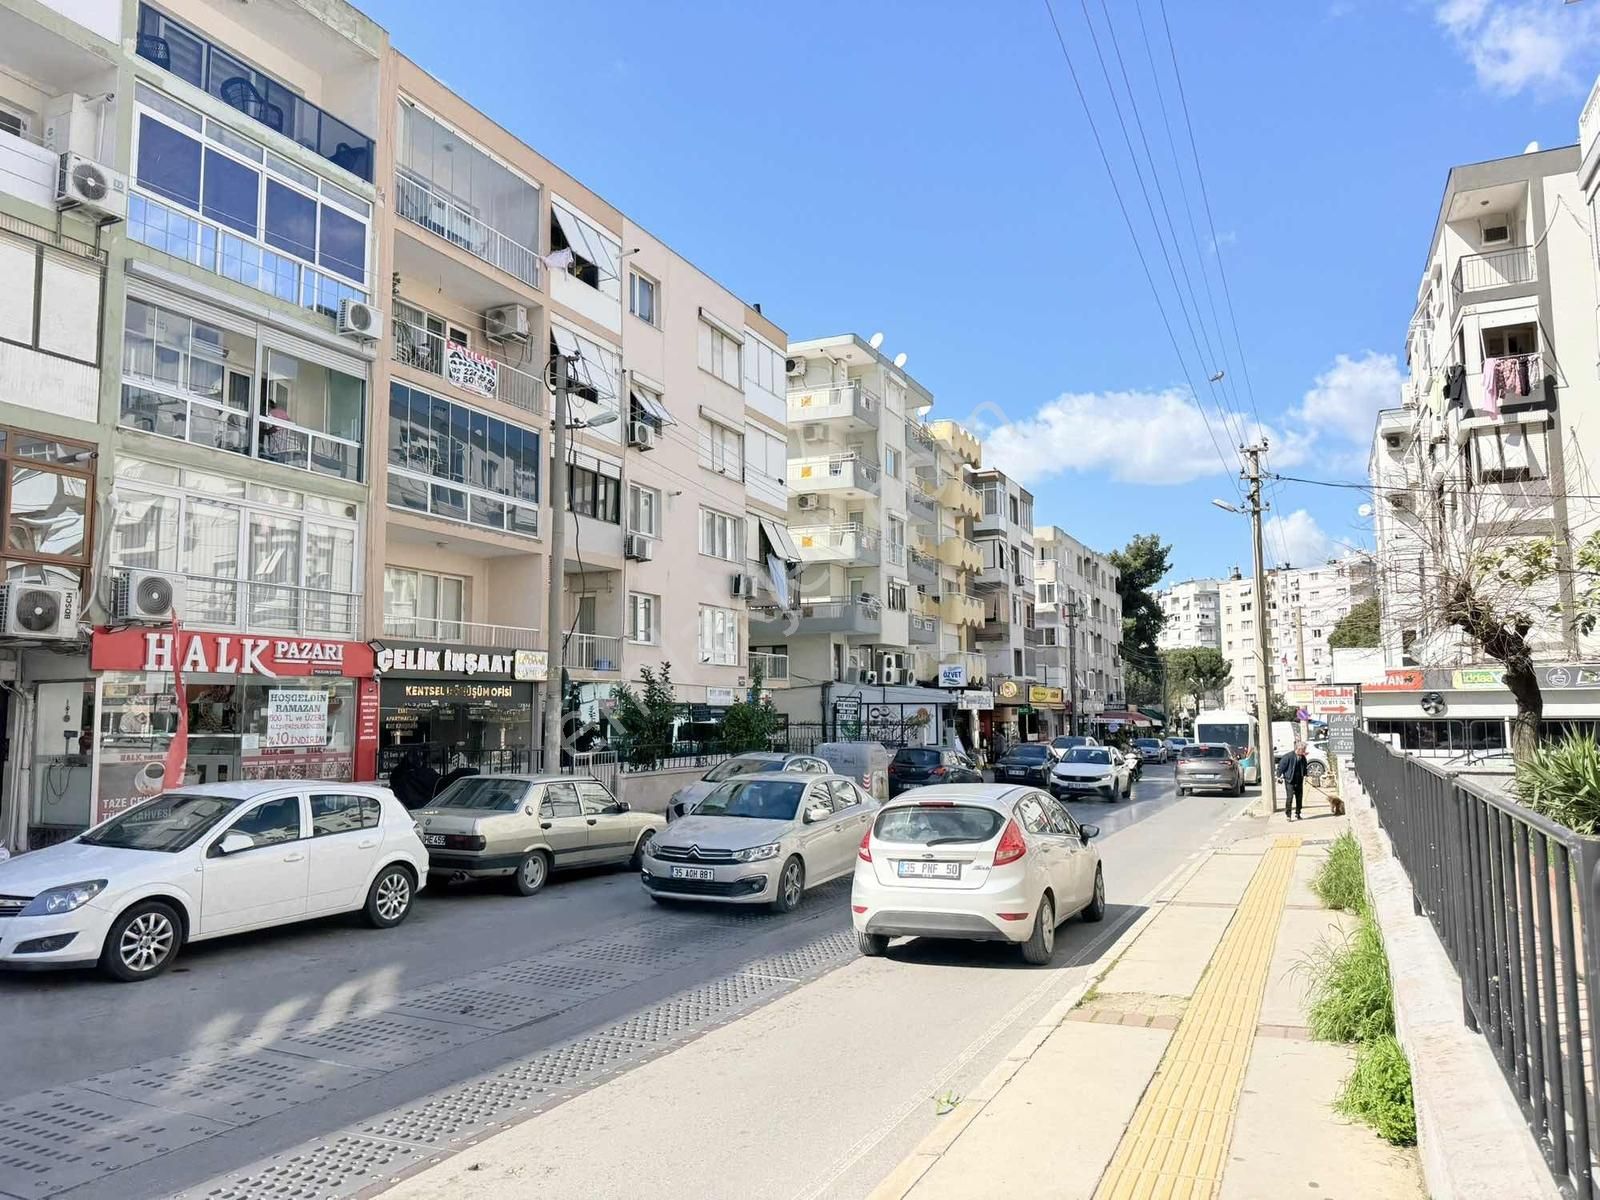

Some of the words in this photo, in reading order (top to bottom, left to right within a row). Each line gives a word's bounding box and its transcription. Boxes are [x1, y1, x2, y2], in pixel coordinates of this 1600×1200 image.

[448, 340, 496, 368] SATILIK
[64, 592, 72, 619] BOSCH
[144, 632, 277, 678] HALK
[274, 640, 344, 660] PAZARI
[377, 647, 441, 673] ÇELİK
[444, 648, 514, 676] İNŞAAT
[942, 669, 962, 679] ÖZVET
[405, 685, 445, 697] KENTSEL
[490, 685, 512, 697] OFİSİ
[271, 693, 327, 704] HOŞGELDİN
[102, 797, 128, 809] TAZE
[673, 868, 683, 877] 35
[699, 870, 712, 879] 881
[904, 862, 916, 873] 35
[921, 863, 938, 874] PNF
[946, 864, 958, 875] 50
